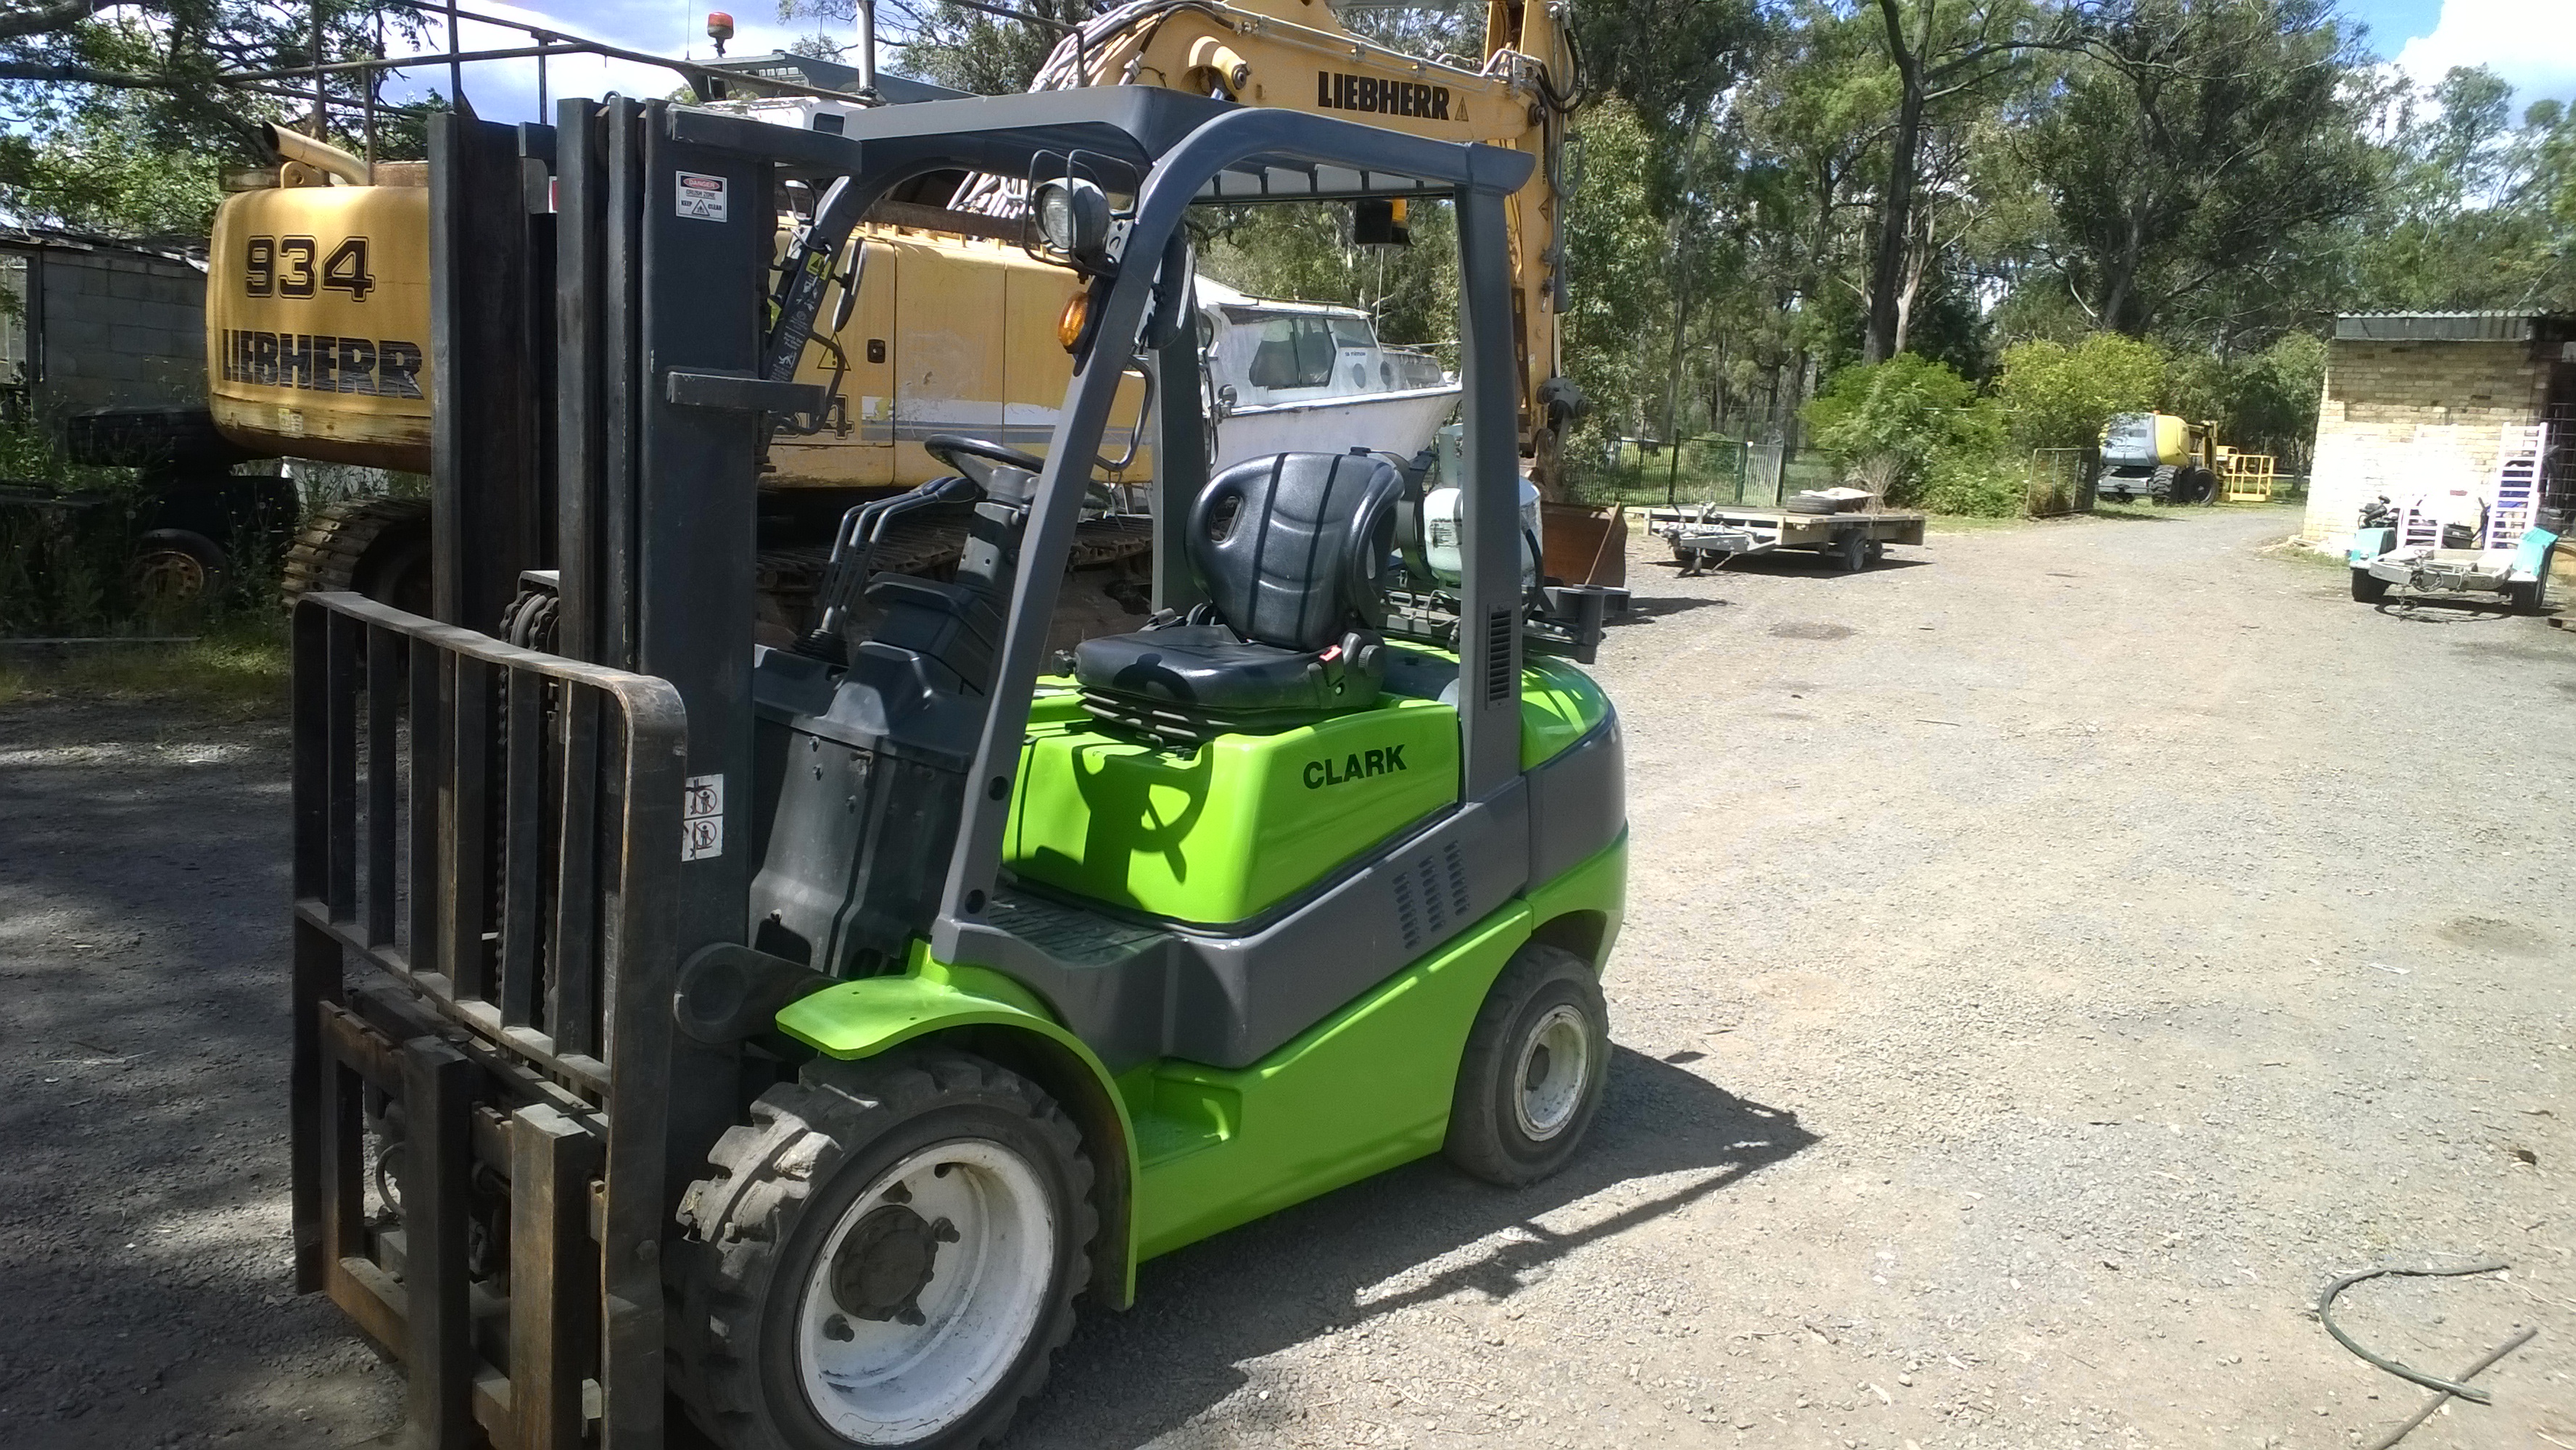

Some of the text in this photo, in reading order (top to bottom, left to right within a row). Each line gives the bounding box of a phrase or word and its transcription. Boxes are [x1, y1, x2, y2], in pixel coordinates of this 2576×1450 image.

[1318, 70, 1450, 120] LIEBHERR
[688, 179, 716, 188] DANGER
[245, 235, 376, 302] 934
[222, 328, 425, 400] LIEBHERR
[1303, 744, 1407, 790] CLARK
